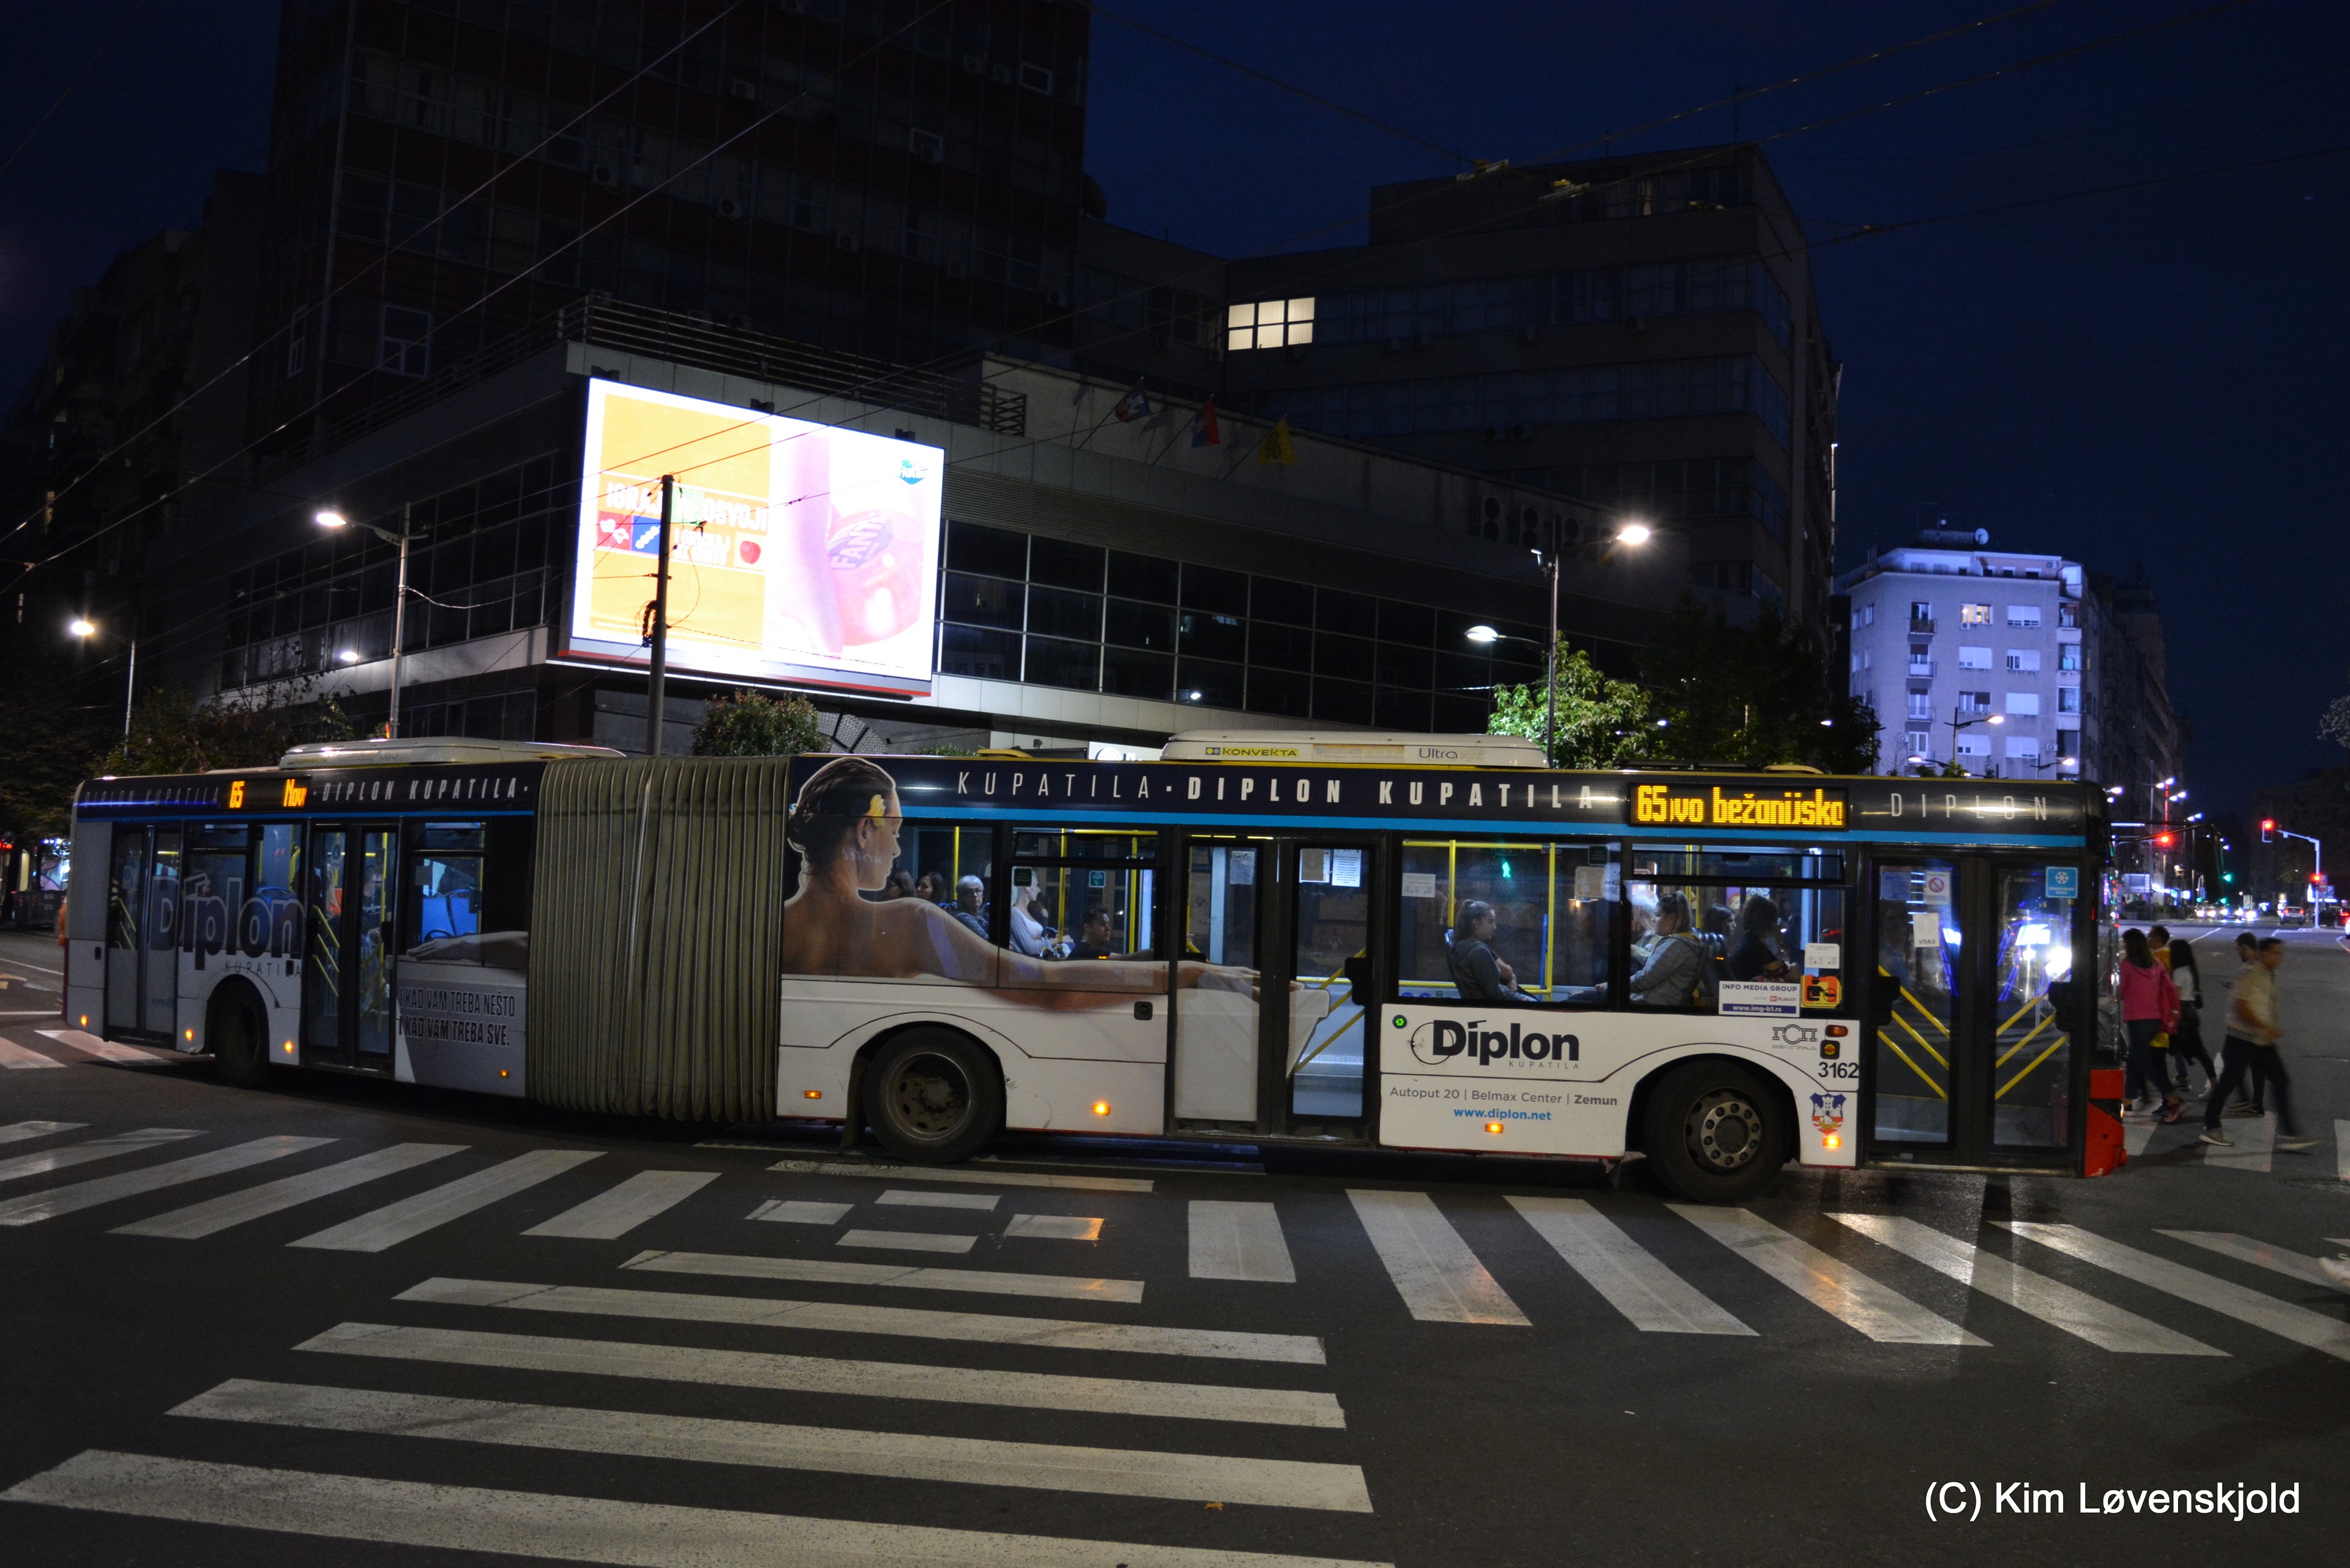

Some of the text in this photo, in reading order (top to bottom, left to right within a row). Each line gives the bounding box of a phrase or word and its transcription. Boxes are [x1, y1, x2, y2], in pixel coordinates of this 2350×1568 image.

[606, 482, 767, 531] IGRAJ OSVOJI
[1223, 747, 1297, 756] KONVEKTA
[1419, 747, 1458, 759] Ultra
[144, 786, 219, 806] KUPATILA
[229, 781, 245, 808] 65
[323, 778, 517, 801] DIPLON KUPATILA
[958, 771, 1592, 809] KUPATILA DIPLON KUPATILA
[1638, 785, 1667, 821] 65
[1890, 793, 2046, 821] DIPLON
[406, 987, 423, 1009] KAD
[427, 988, 447, 1011] VAM
[450, 991, 480, 1014] TREBA
[484, 990, 515, 1017] NEŠTO
[405, 1017, 424, 1037] KAD
[428, 1018, 449, 1040] VAM
[452, 1020, 483, 1043] TREBA
[487, 1023, 510, 1047] SVE.
[1509, 1061, 1579, 1070] KUPATILA
[1818, 1061, 1859, 1078] 3162
[1390, 1086, 1618, 1106] Autoput 20 Belmax Center Zemun
[1453, 1108, 1552, 1121] www.diplon.net
